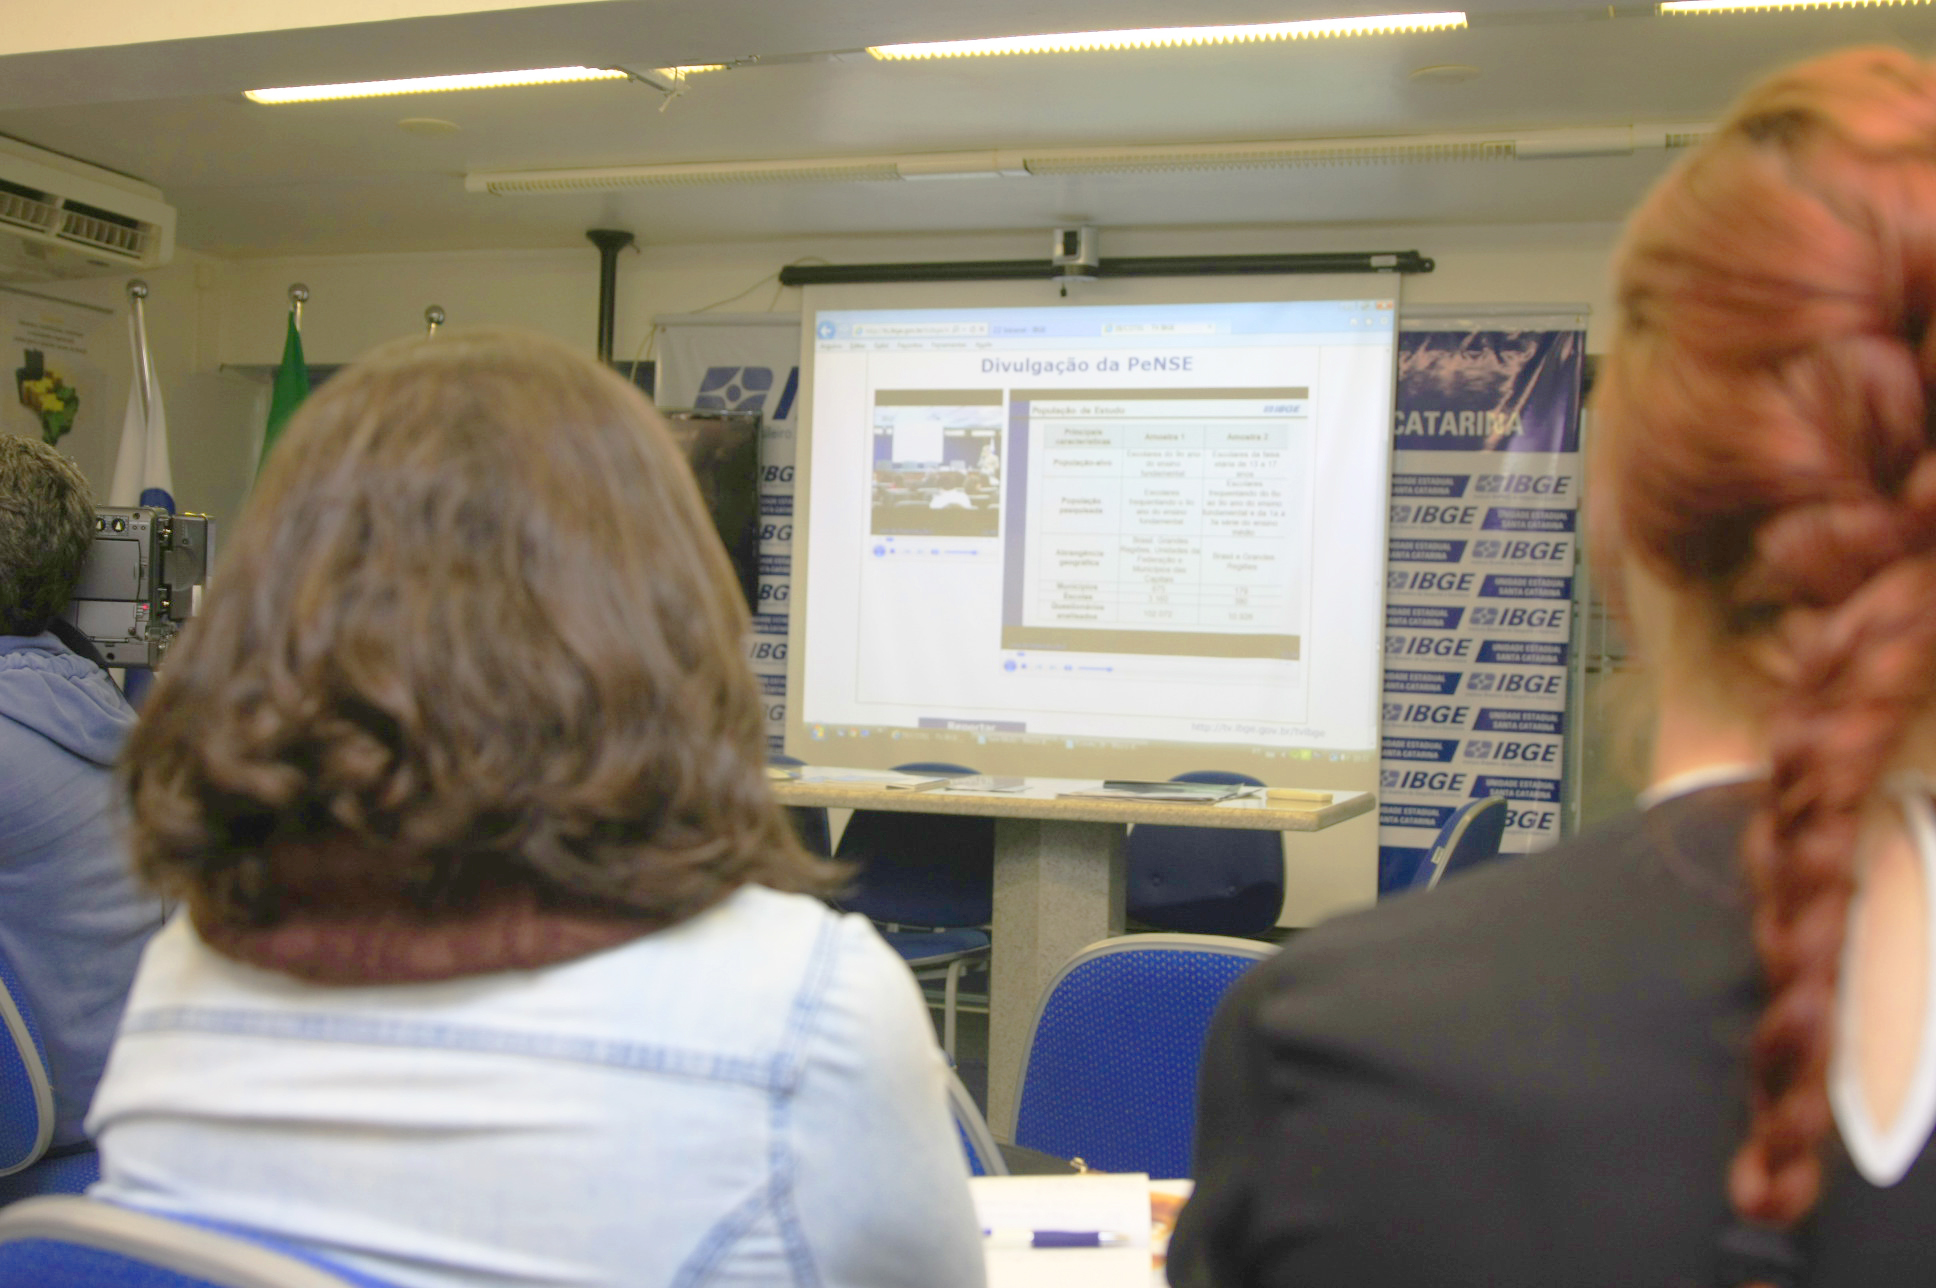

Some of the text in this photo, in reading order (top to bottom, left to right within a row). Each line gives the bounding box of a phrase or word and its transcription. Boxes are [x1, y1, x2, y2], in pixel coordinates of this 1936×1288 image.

[981, 356, 1193, 376] Divulgação da PeNSE
[1395, 410, 1525, 437] CATARINA
[1393, 486, 1413, 494] ANTA
[1503, 474, 1571, 494] IBGE
[1412, 506, 1478, 524] IBGE
[760, 524, 792, 540] BG
[1501, 520, 1564, 529] SANTA CATARINA
[1390, 551, 1410, 559] ANTA
[1502, 540, 1568, 560] IBGE
[1409, 572, 1475, 591] IBGE
[760, 584, 790, 601] BG
[1498, 587, 1561, 596] SANTA CATARINA
[1499, 608, 1565, 628] IBGE
[1406, 638, 1472, 656] IBGE
[1496, 653, 1558, 662] SANTA CATARINA
[1385, 682, 1404, 690] ANTA
[1497, 674, 1562, 693] IBGE
[1404, 705, 1470, 723] IBGE
[1493, 721, 1555, 731] SANTA CATARINA
[1383, 749, 1401, 757] ANTA
[1493, 742, 1558, 762] IBGE
[1401, 772, 1467, 791] IBGE
[1490, 789, 1552, 799] SANTA CATARINA
[1381, 816, 1399, 824] ANTA
[1505, 809, 1555, 830] BGE
